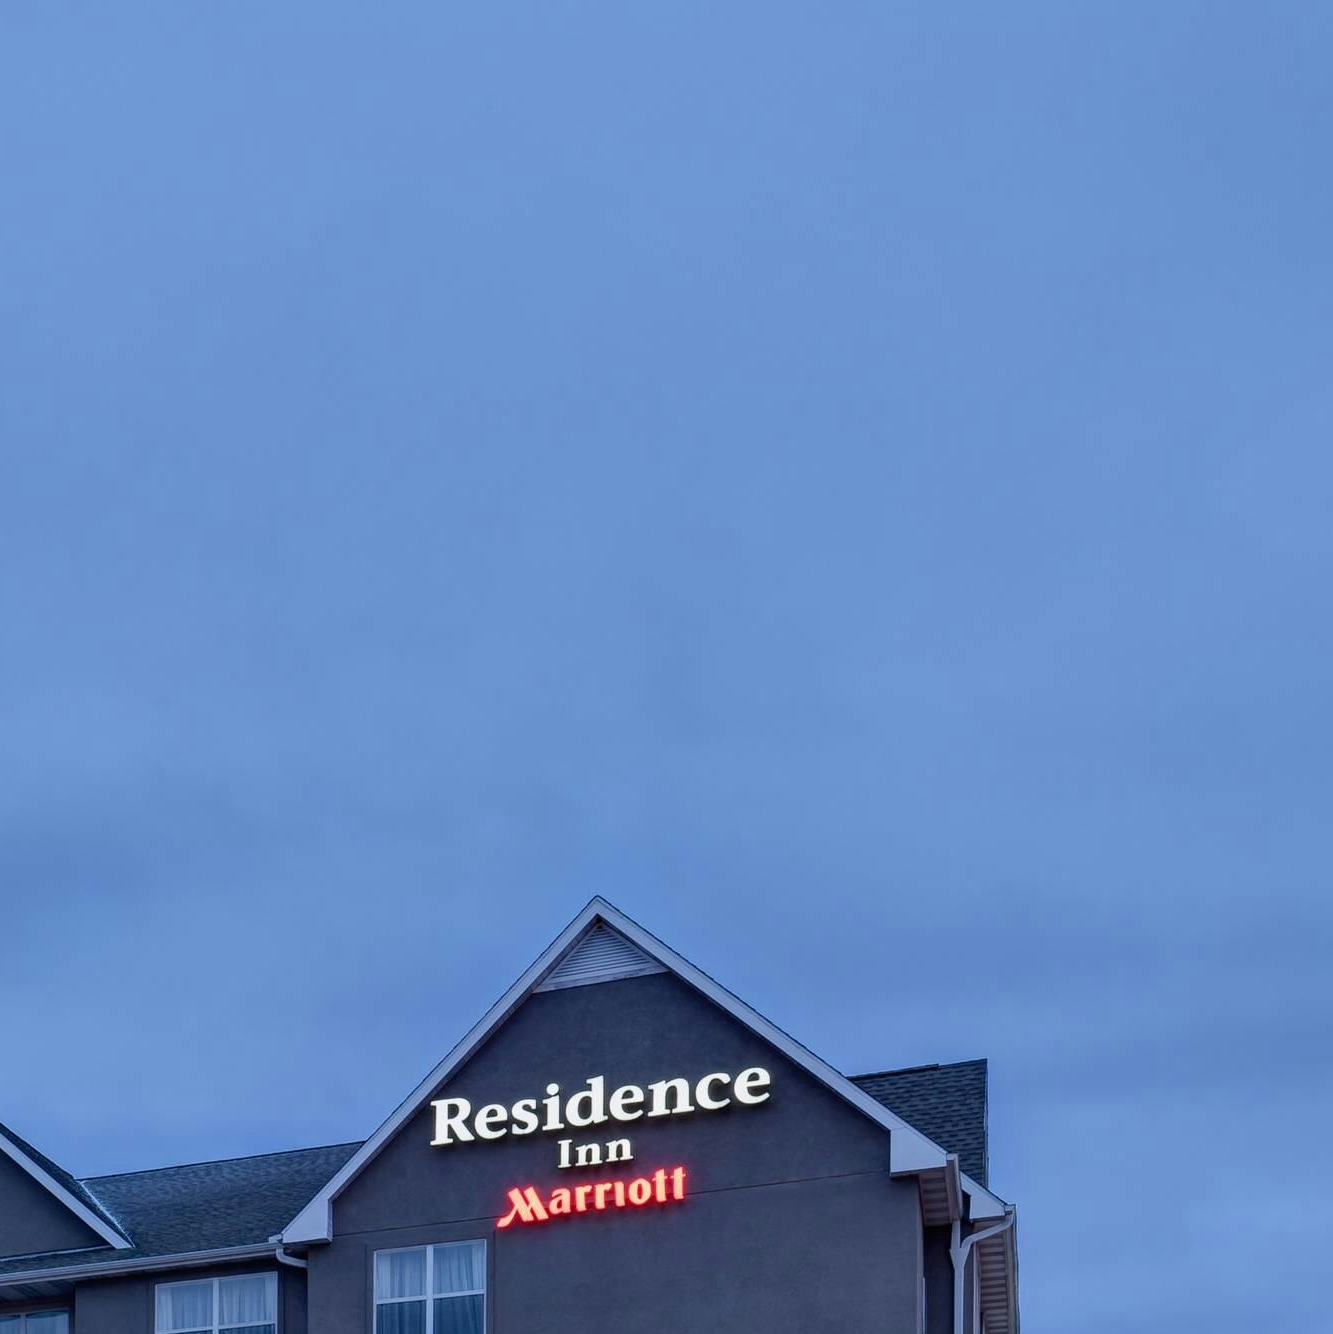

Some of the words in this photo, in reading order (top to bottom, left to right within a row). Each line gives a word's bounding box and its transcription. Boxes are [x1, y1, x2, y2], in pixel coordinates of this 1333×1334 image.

[429, 1065, 771, 1146] Residence
[557, 1137, 634, 1169] Inn
[496, 1166, 686, 1228] Marriott
